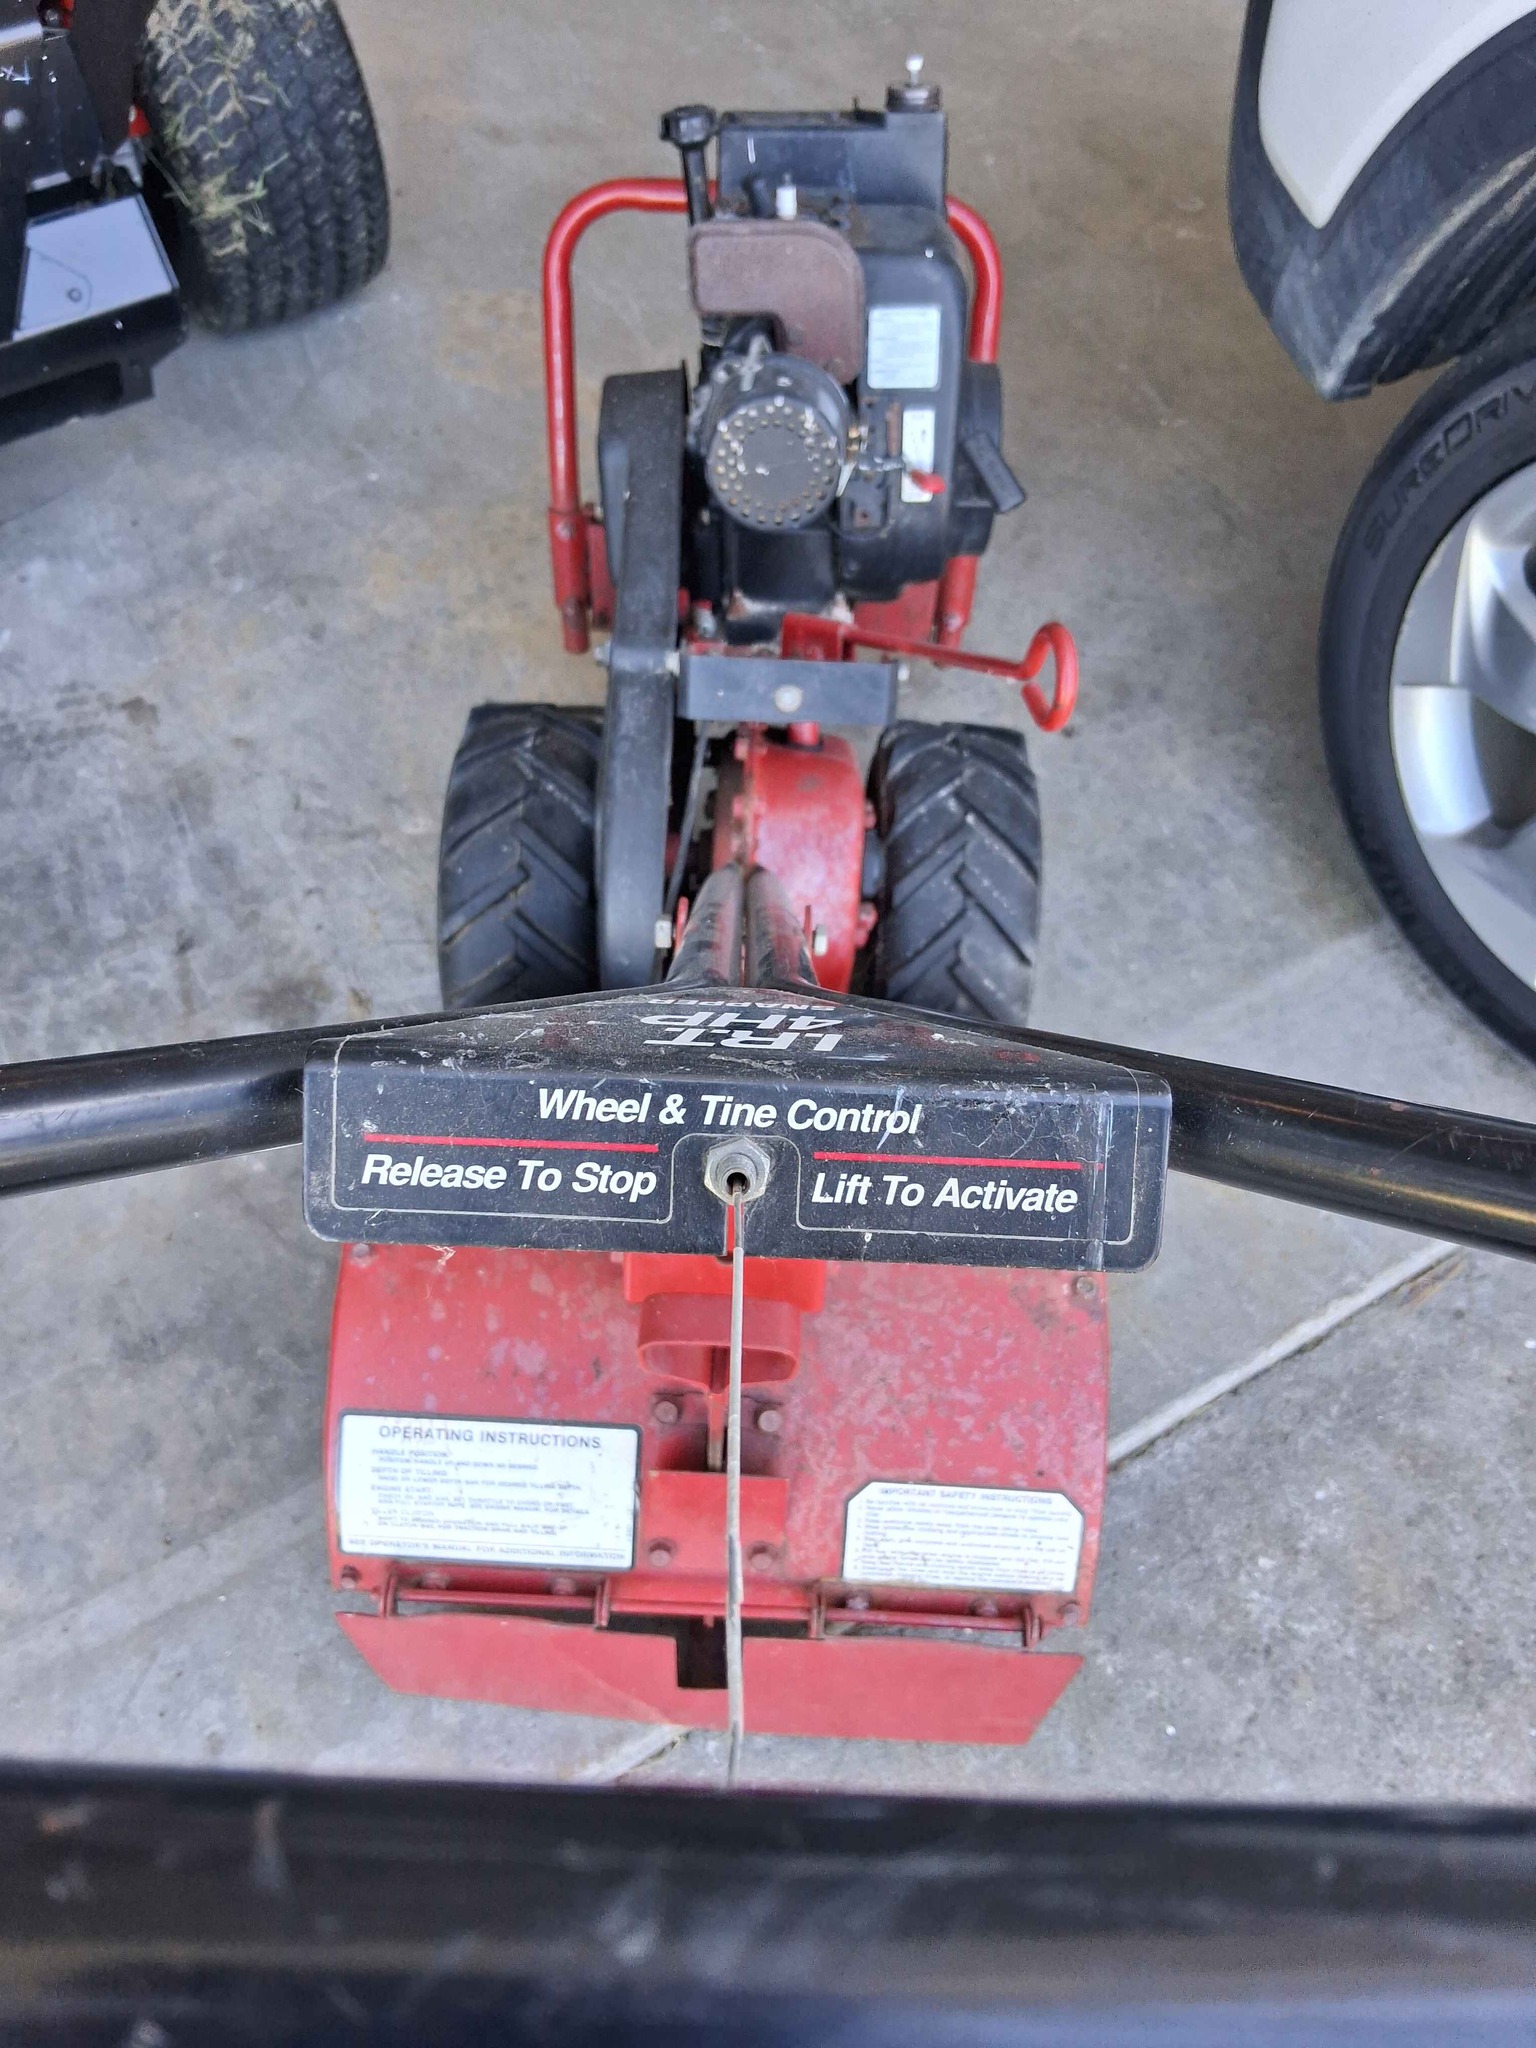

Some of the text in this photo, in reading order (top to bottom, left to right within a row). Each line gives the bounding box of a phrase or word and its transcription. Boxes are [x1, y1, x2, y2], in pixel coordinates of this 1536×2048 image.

[641, 1011, 844, 1030] 4HP
[538, 1088, 923, 1134] Wheel & Tine Control
[361, 1154, 657, 1203] Release To Stop
[811, 1172, 1079, 1213] Lift To Activate
[379, 1425, 602, 1448] OPERATING INSTRUCTIONS
